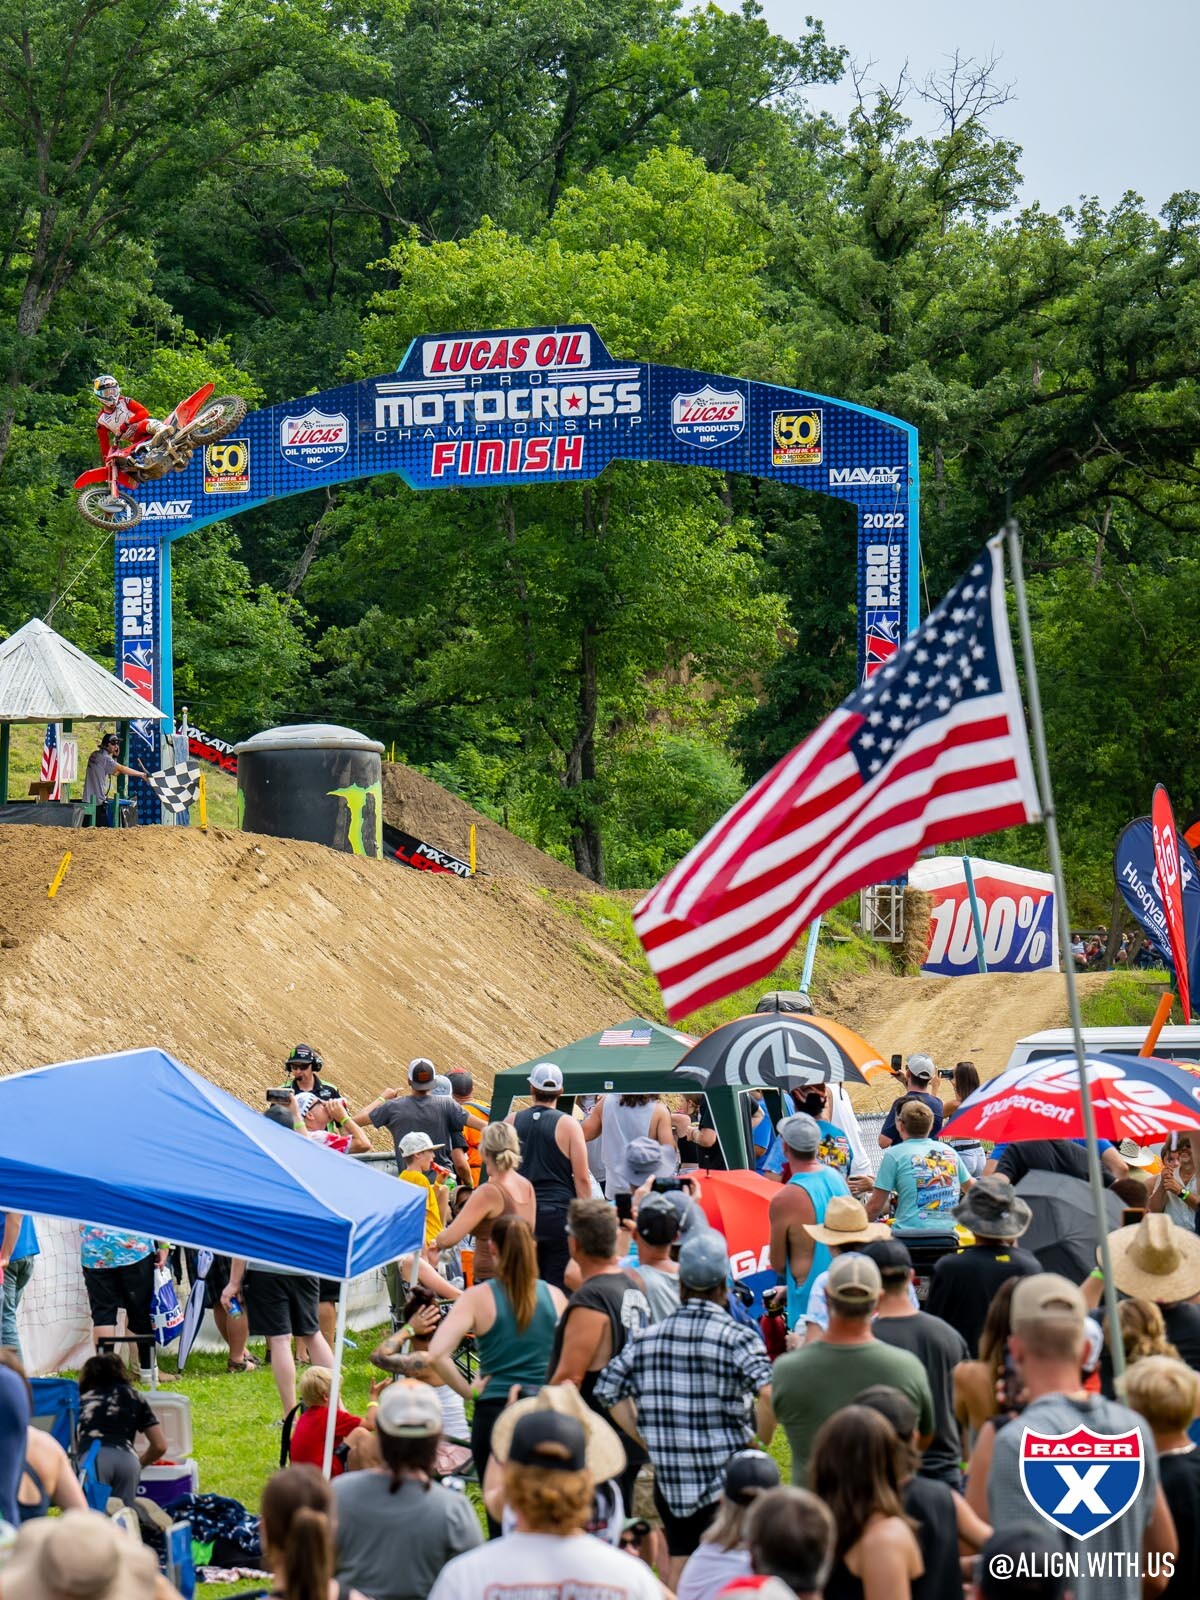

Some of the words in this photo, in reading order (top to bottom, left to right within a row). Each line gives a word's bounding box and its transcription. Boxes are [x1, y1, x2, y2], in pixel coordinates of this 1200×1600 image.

[430, 338, 531, 373] LUCAS
[535, 334, 584, 365] OIL
[471, 373, 543, 389] PRO
[375, 382, 641, 428] MOTOCROSS
[680, 405, 739, 422] LUCAS
[288, 427, 344, 445] LUCAS
[375, 416, 642, 442] CHAMPIONSHIP
[693, 424, 740, 433] PRODUCTS
[700, 435, 718, 443] INC.
[779, 415, 817, 445] 50
[211, 445, 244, 473] 50
[301, 446, 344, 455] PRODUCTS
[307, 456, 323, 464] INC.
[431, 435, 585, 477] FINISH
[874, 475, 894, 483] PLUS
[863, 513, 905, 529] 2022
[120, 547, 155, 562] 2022
[866, 544, 889, 606] PRO
[889, 544, 901, 606] RACING
[123, 577, 142, 636] PRO
[143, 576, 152, 635] RACING
[62, 742, 75, 780] 21
[926, 895, 1047, 965] 100%
